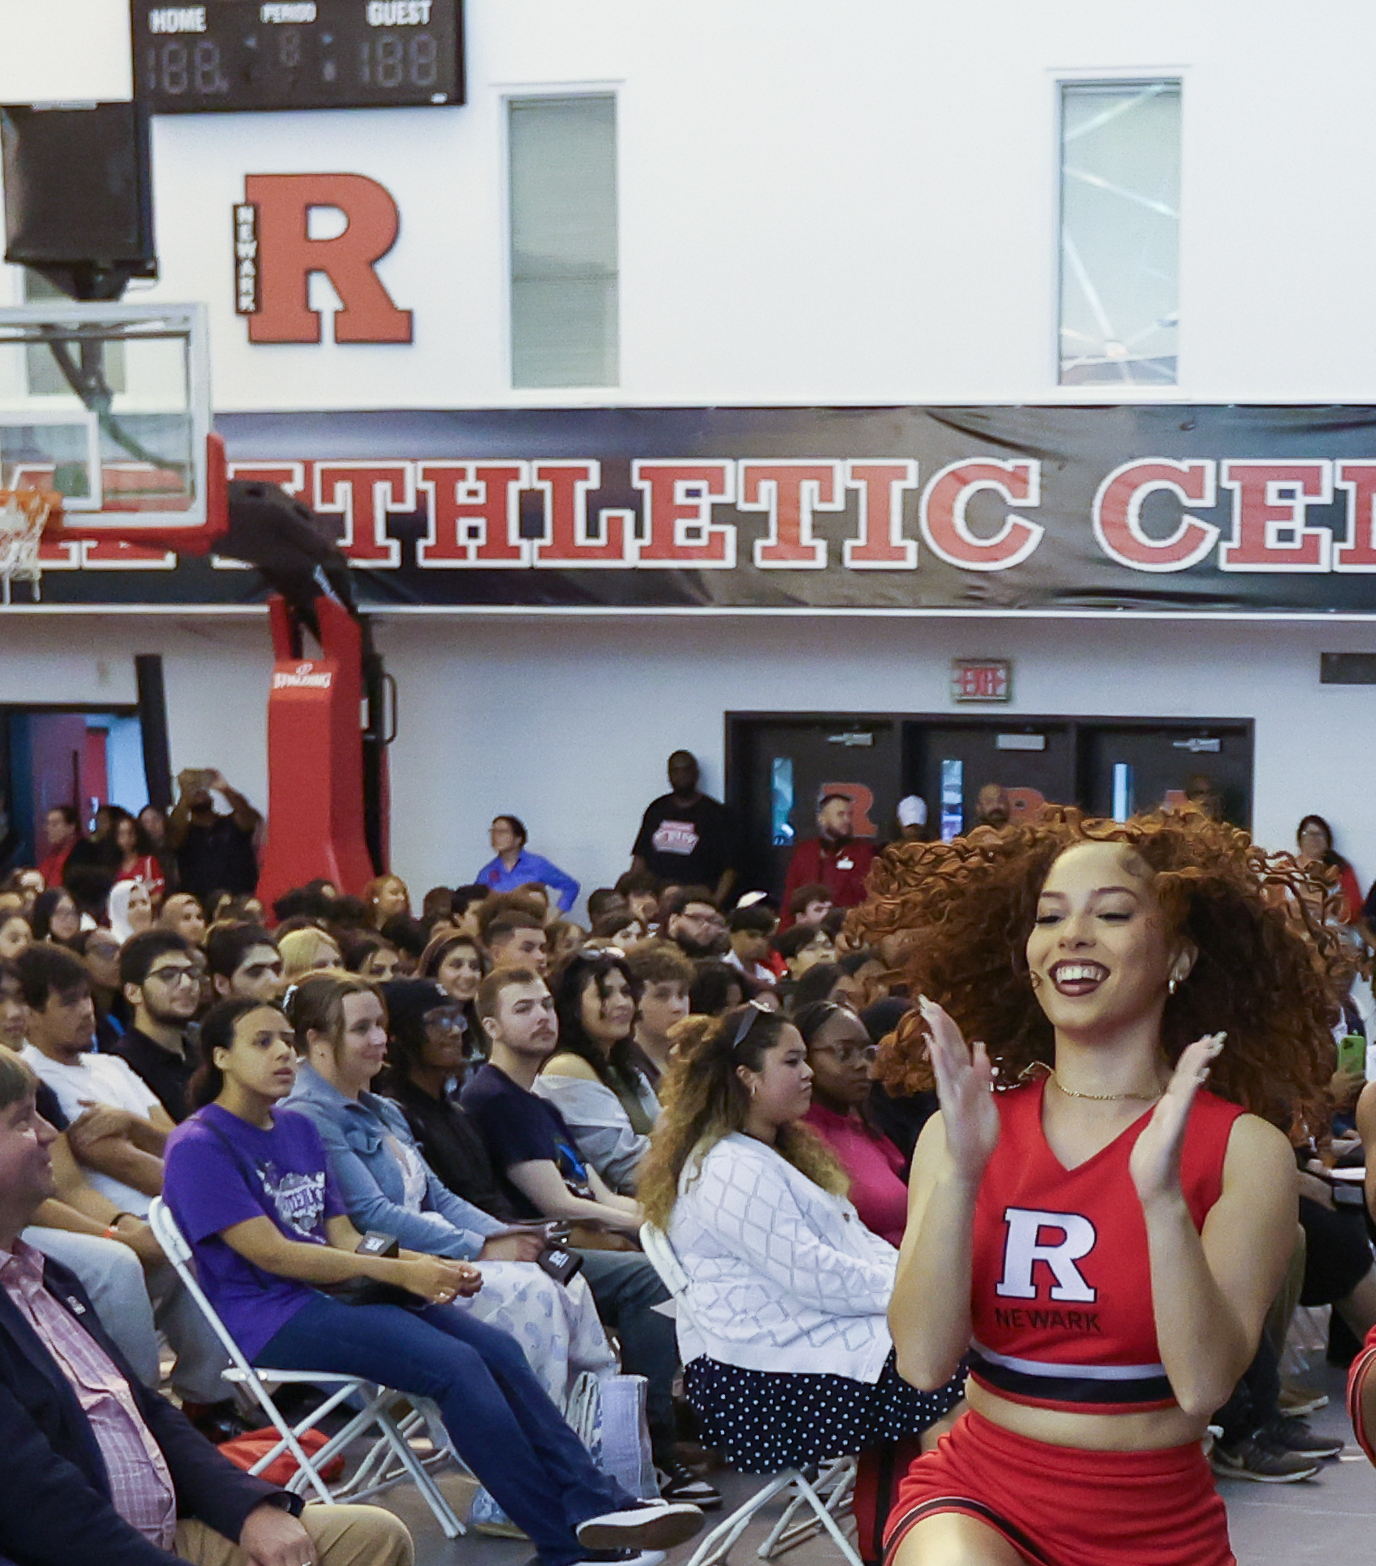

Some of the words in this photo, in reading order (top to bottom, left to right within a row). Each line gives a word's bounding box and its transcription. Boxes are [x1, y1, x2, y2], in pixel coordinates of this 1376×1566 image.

[149, 6, 207, 33] HOME
[366, 0, 431, 26] GUEST
[234, 204, 257, 314] NEWARK
[244, 173, 413, 344] R
[209, 459, 1043, 571] THLETIC
[995, 1206, 1097, 1303] R
[995, 1307, 1102, 1332] NEWARK
